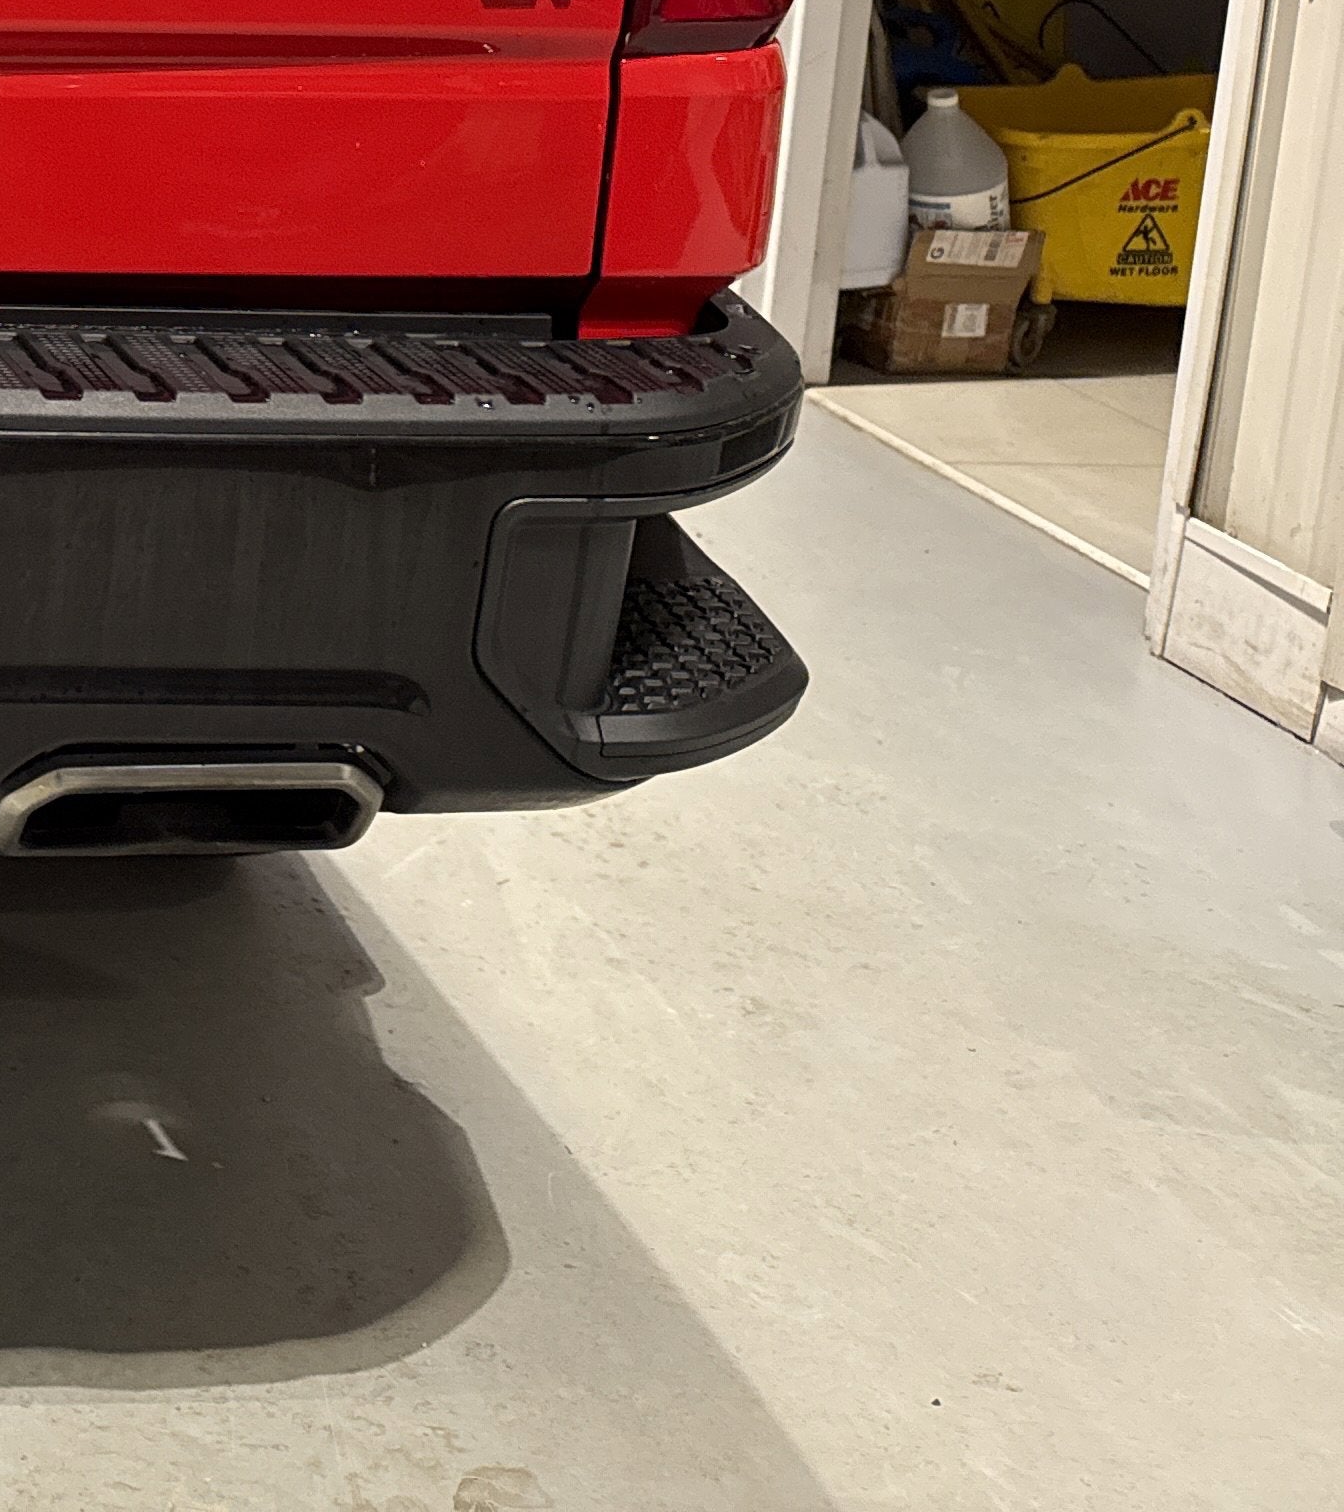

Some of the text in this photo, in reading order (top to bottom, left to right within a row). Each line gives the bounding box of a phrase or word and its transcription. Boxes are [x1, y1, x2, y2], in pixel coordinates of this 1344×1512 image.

[1119, 176, 1180, 201] ACE
[1118, 204, 1178, 213] Hardware
[1119, 255, 1171, 264] CAUTION
[1110, 266, 1179, 277] WET FLOOR
